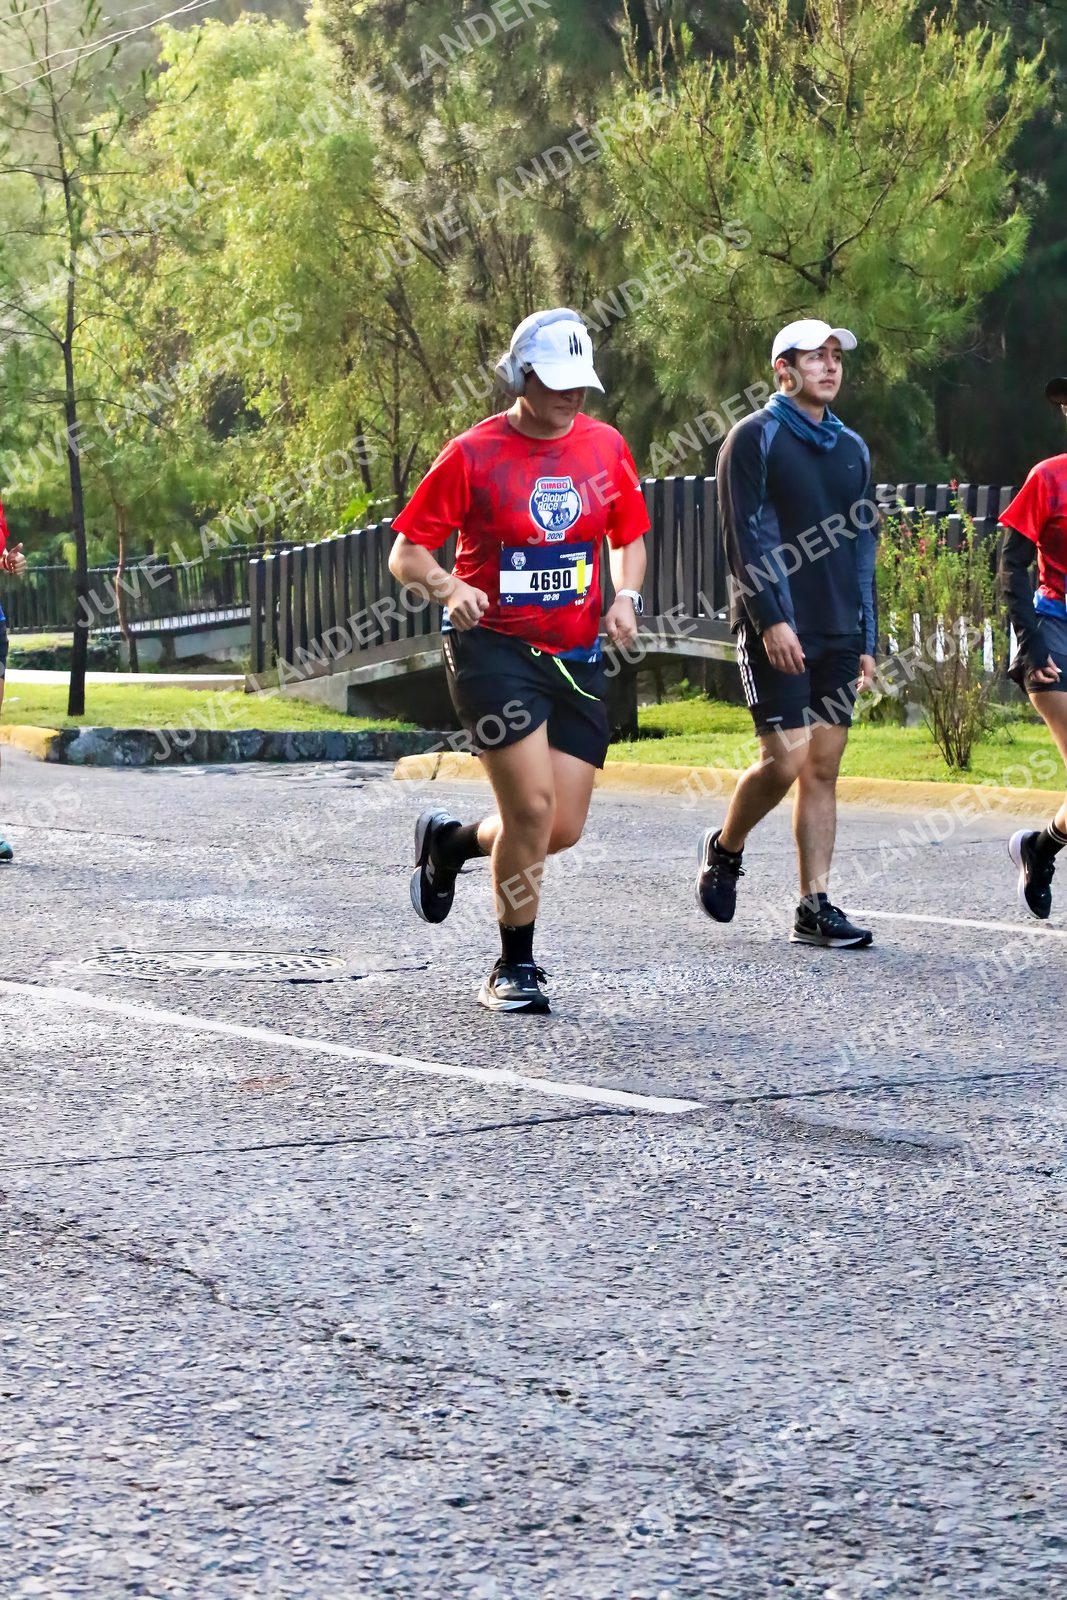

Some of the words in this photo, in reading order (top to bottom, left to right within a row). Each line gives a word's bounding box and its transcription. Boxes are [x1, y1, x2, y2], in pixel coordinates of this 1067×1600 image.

[541, 482, 567, 490] BIMBO
[541, 492, 568, 503] Global
[537, 501, 558, 511] Race
[547, 532, 564, 540] 2026
[530, 569, 572, 591] 4690
